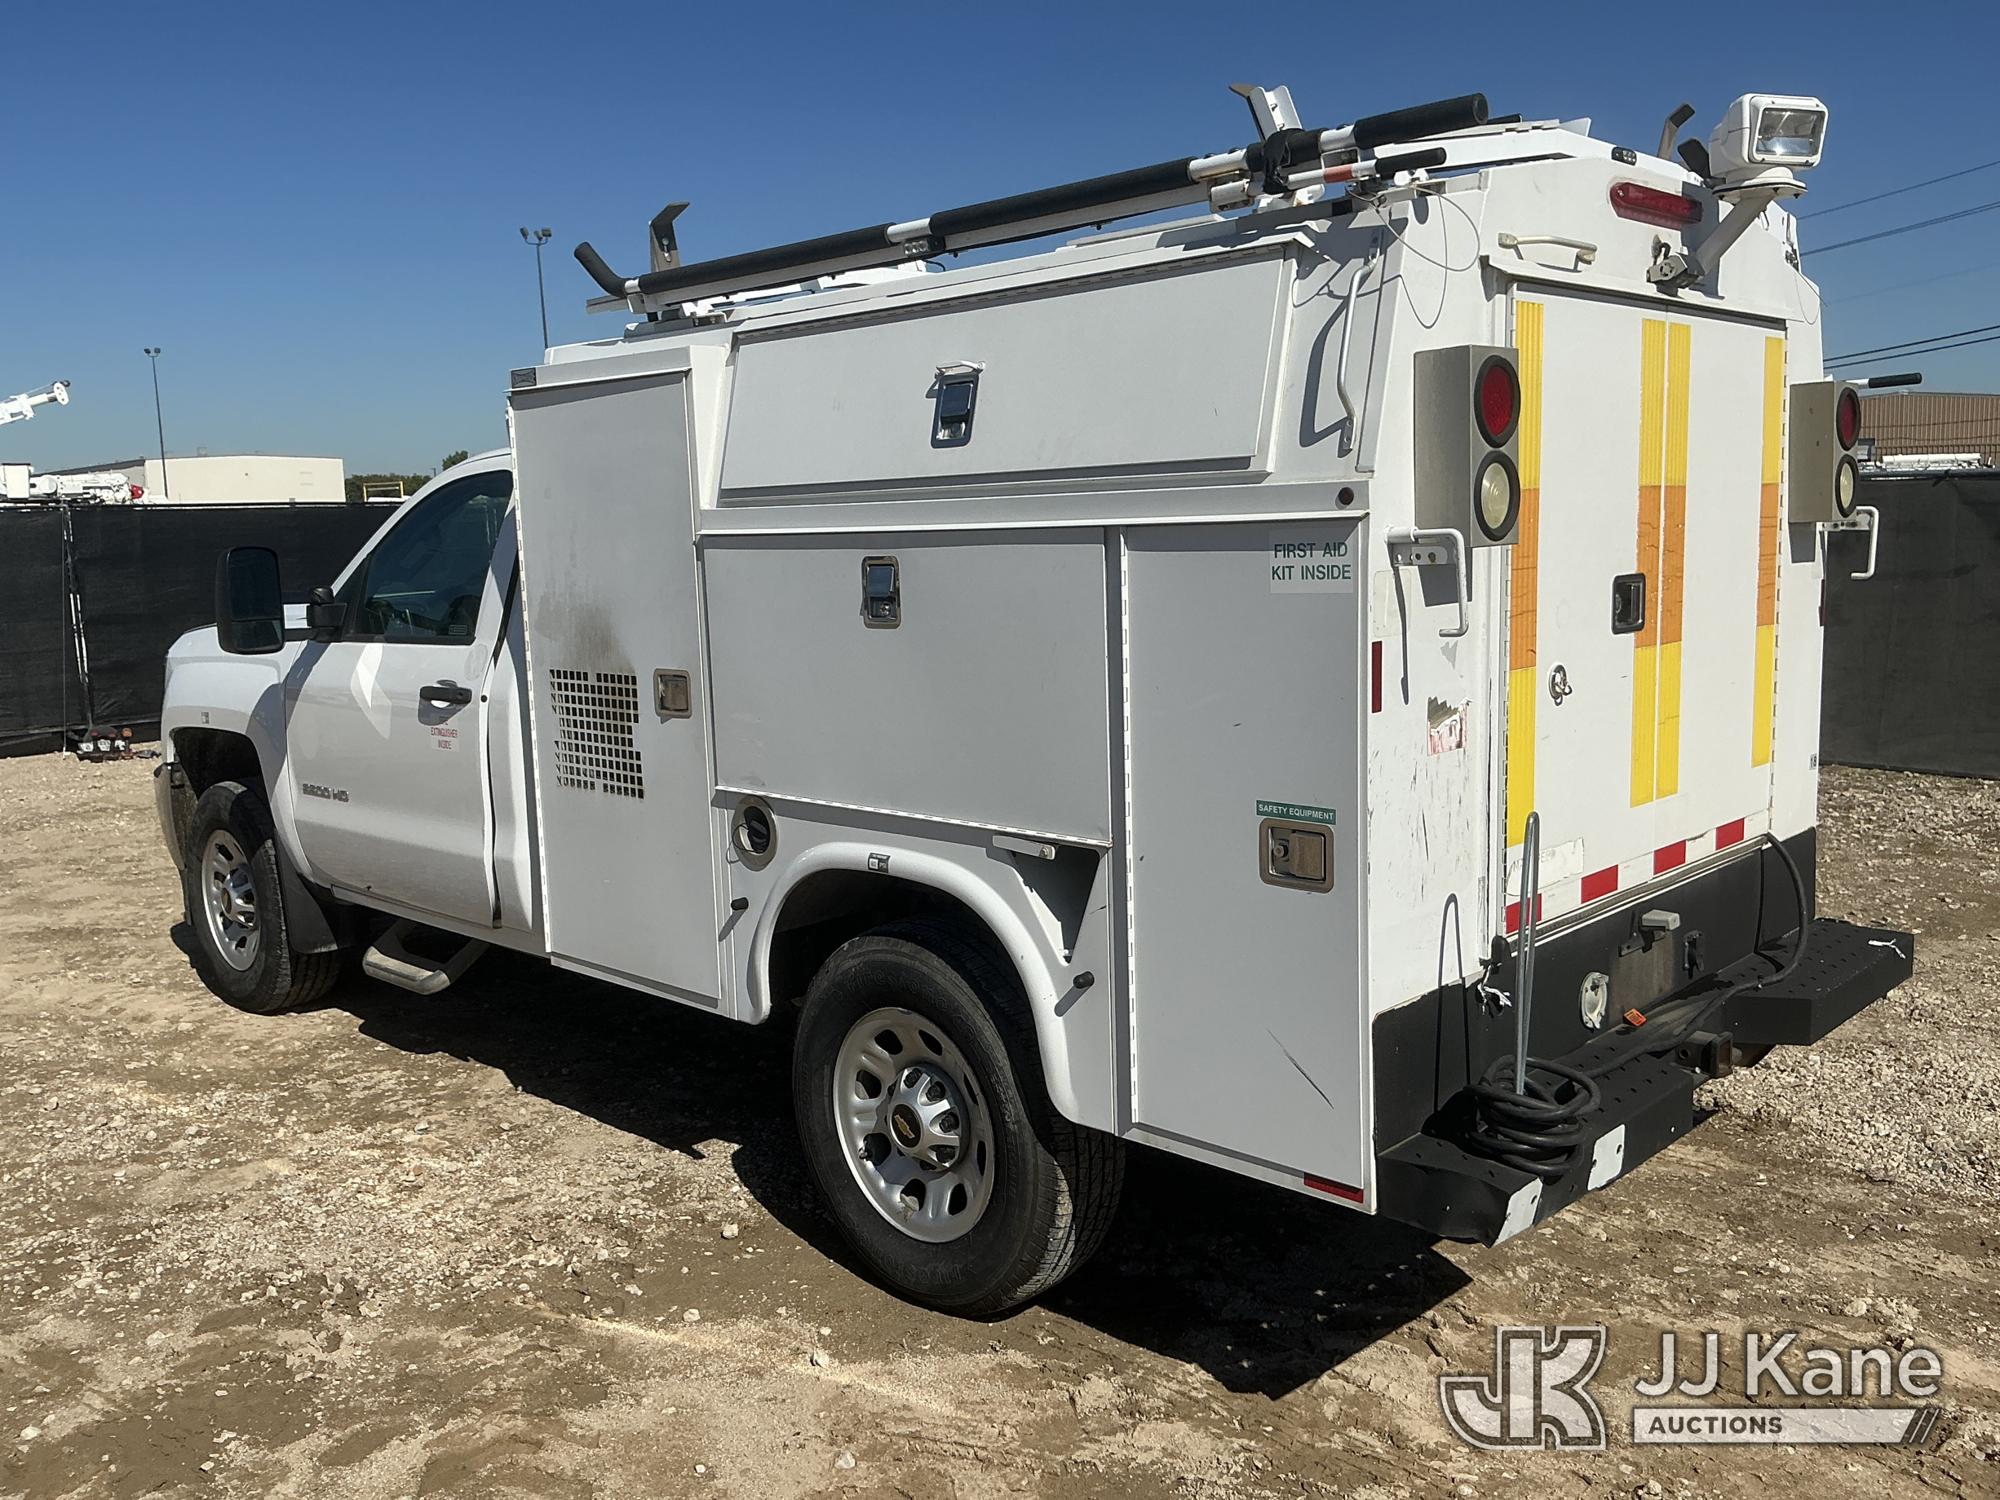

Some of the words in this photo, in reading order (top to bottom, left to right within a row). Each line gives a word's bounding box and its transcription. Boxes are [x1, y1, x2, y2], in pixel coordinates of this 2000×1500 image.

[1274, 543, 1316, 559] FIRST
[1322, 542, 1348, 558] AID
[1271, 565, 1295, 580] KIT
[1301, 564, 1351, 580] INSIDE
[1258, 804, 1288, 815] SAFETY
[1288, 807, 1334, 820] EQUIPMENT
